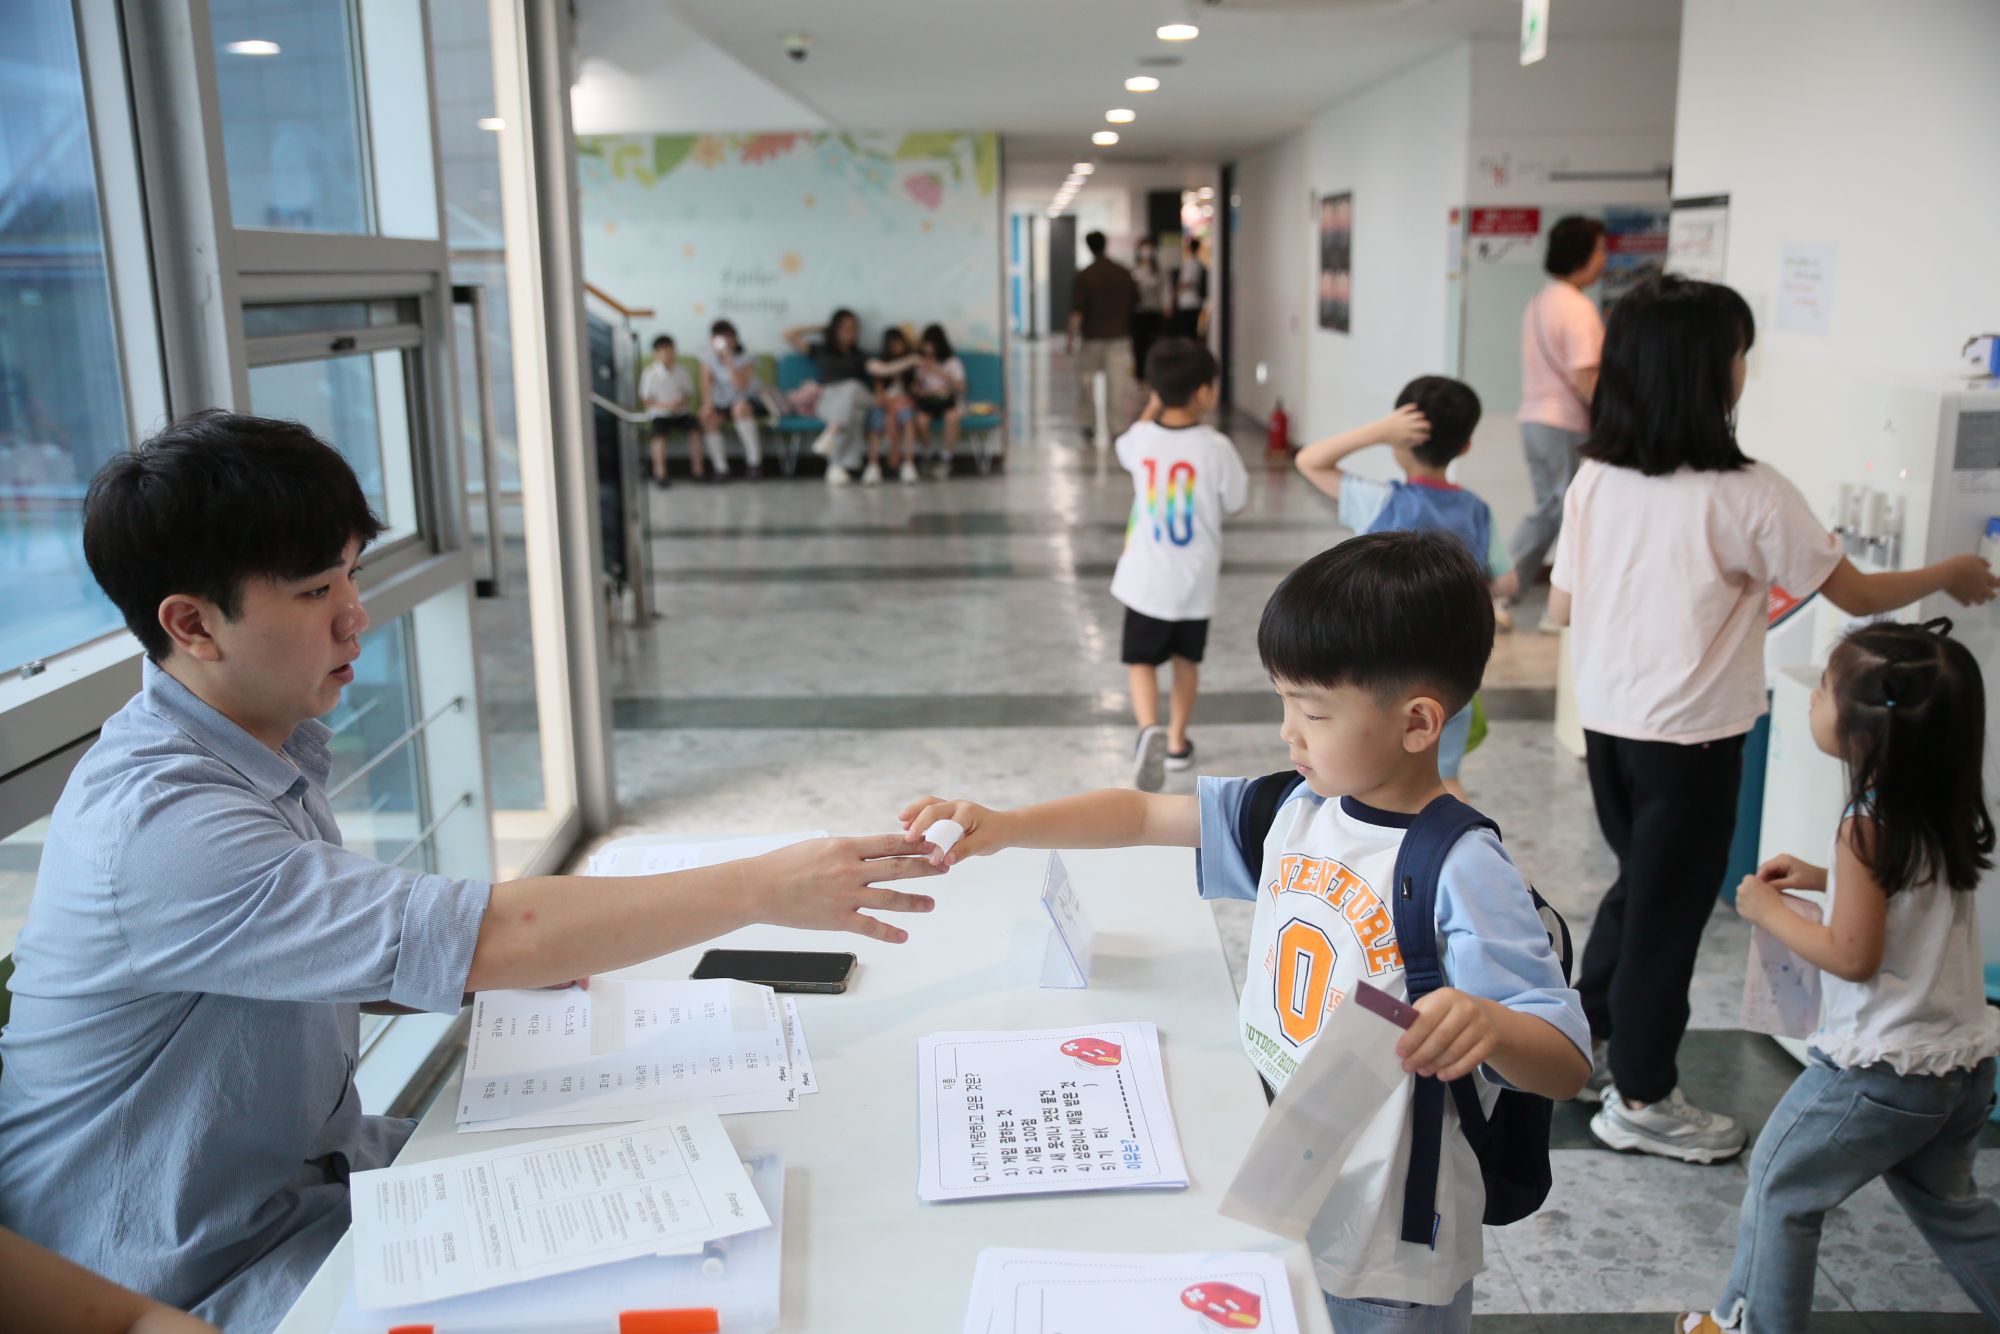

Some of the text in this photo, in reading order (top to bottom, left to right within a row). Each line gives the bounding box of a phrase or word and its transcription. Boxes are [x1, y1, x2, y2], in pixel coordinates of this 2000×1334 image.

[1142, 458, 1196, 547] 10
[1268, 854, 1405, 977] VENTURE
[1273, 917, 1338, 1048] 0
[942, 1077, 956, 1089] 이름
[1264, 1060, 1286, 1083] PERFECT
[964, 1071, 990, 1182] Q. 내가 자랑하고 싶은 것은?
[996, 1108, 1019, 1176] 1) 게임 잘하는 것
[1020, 1118, 1044, 1175] 2) 시험 100점
[1039, 1089, 1068, 1173] 3) 새 옷이나 멋진 물건
[1059, 1080, 1092, 1172] 4) 상장이나 메달 받은 것
[1097, 1149, 1114, 1158] 기
[1119, 1138, 1144, 1169] 이유는?
[1098, 1161, 1117, 1171] 5)
